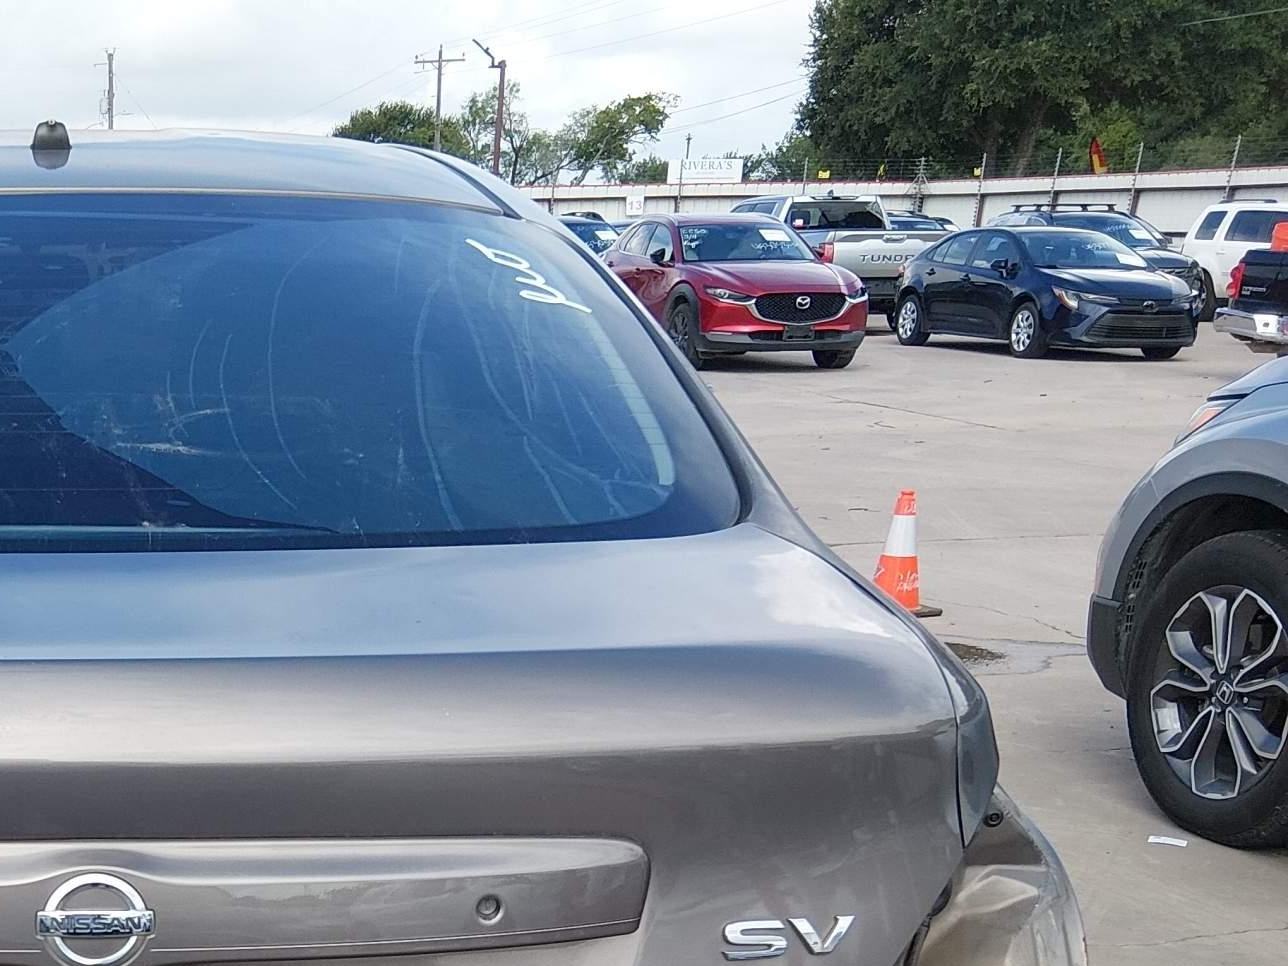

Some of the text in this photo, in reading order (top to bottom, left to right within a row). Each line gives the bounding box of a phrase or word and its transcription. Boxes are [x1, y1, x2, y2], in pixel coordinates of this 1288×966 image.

[680, 160, 733, 172] RIVERA'S
[628, 200, 643, 210] 13
[50, 916, 143, 934] NISSAN
[721, 915, 857, 962] SV
